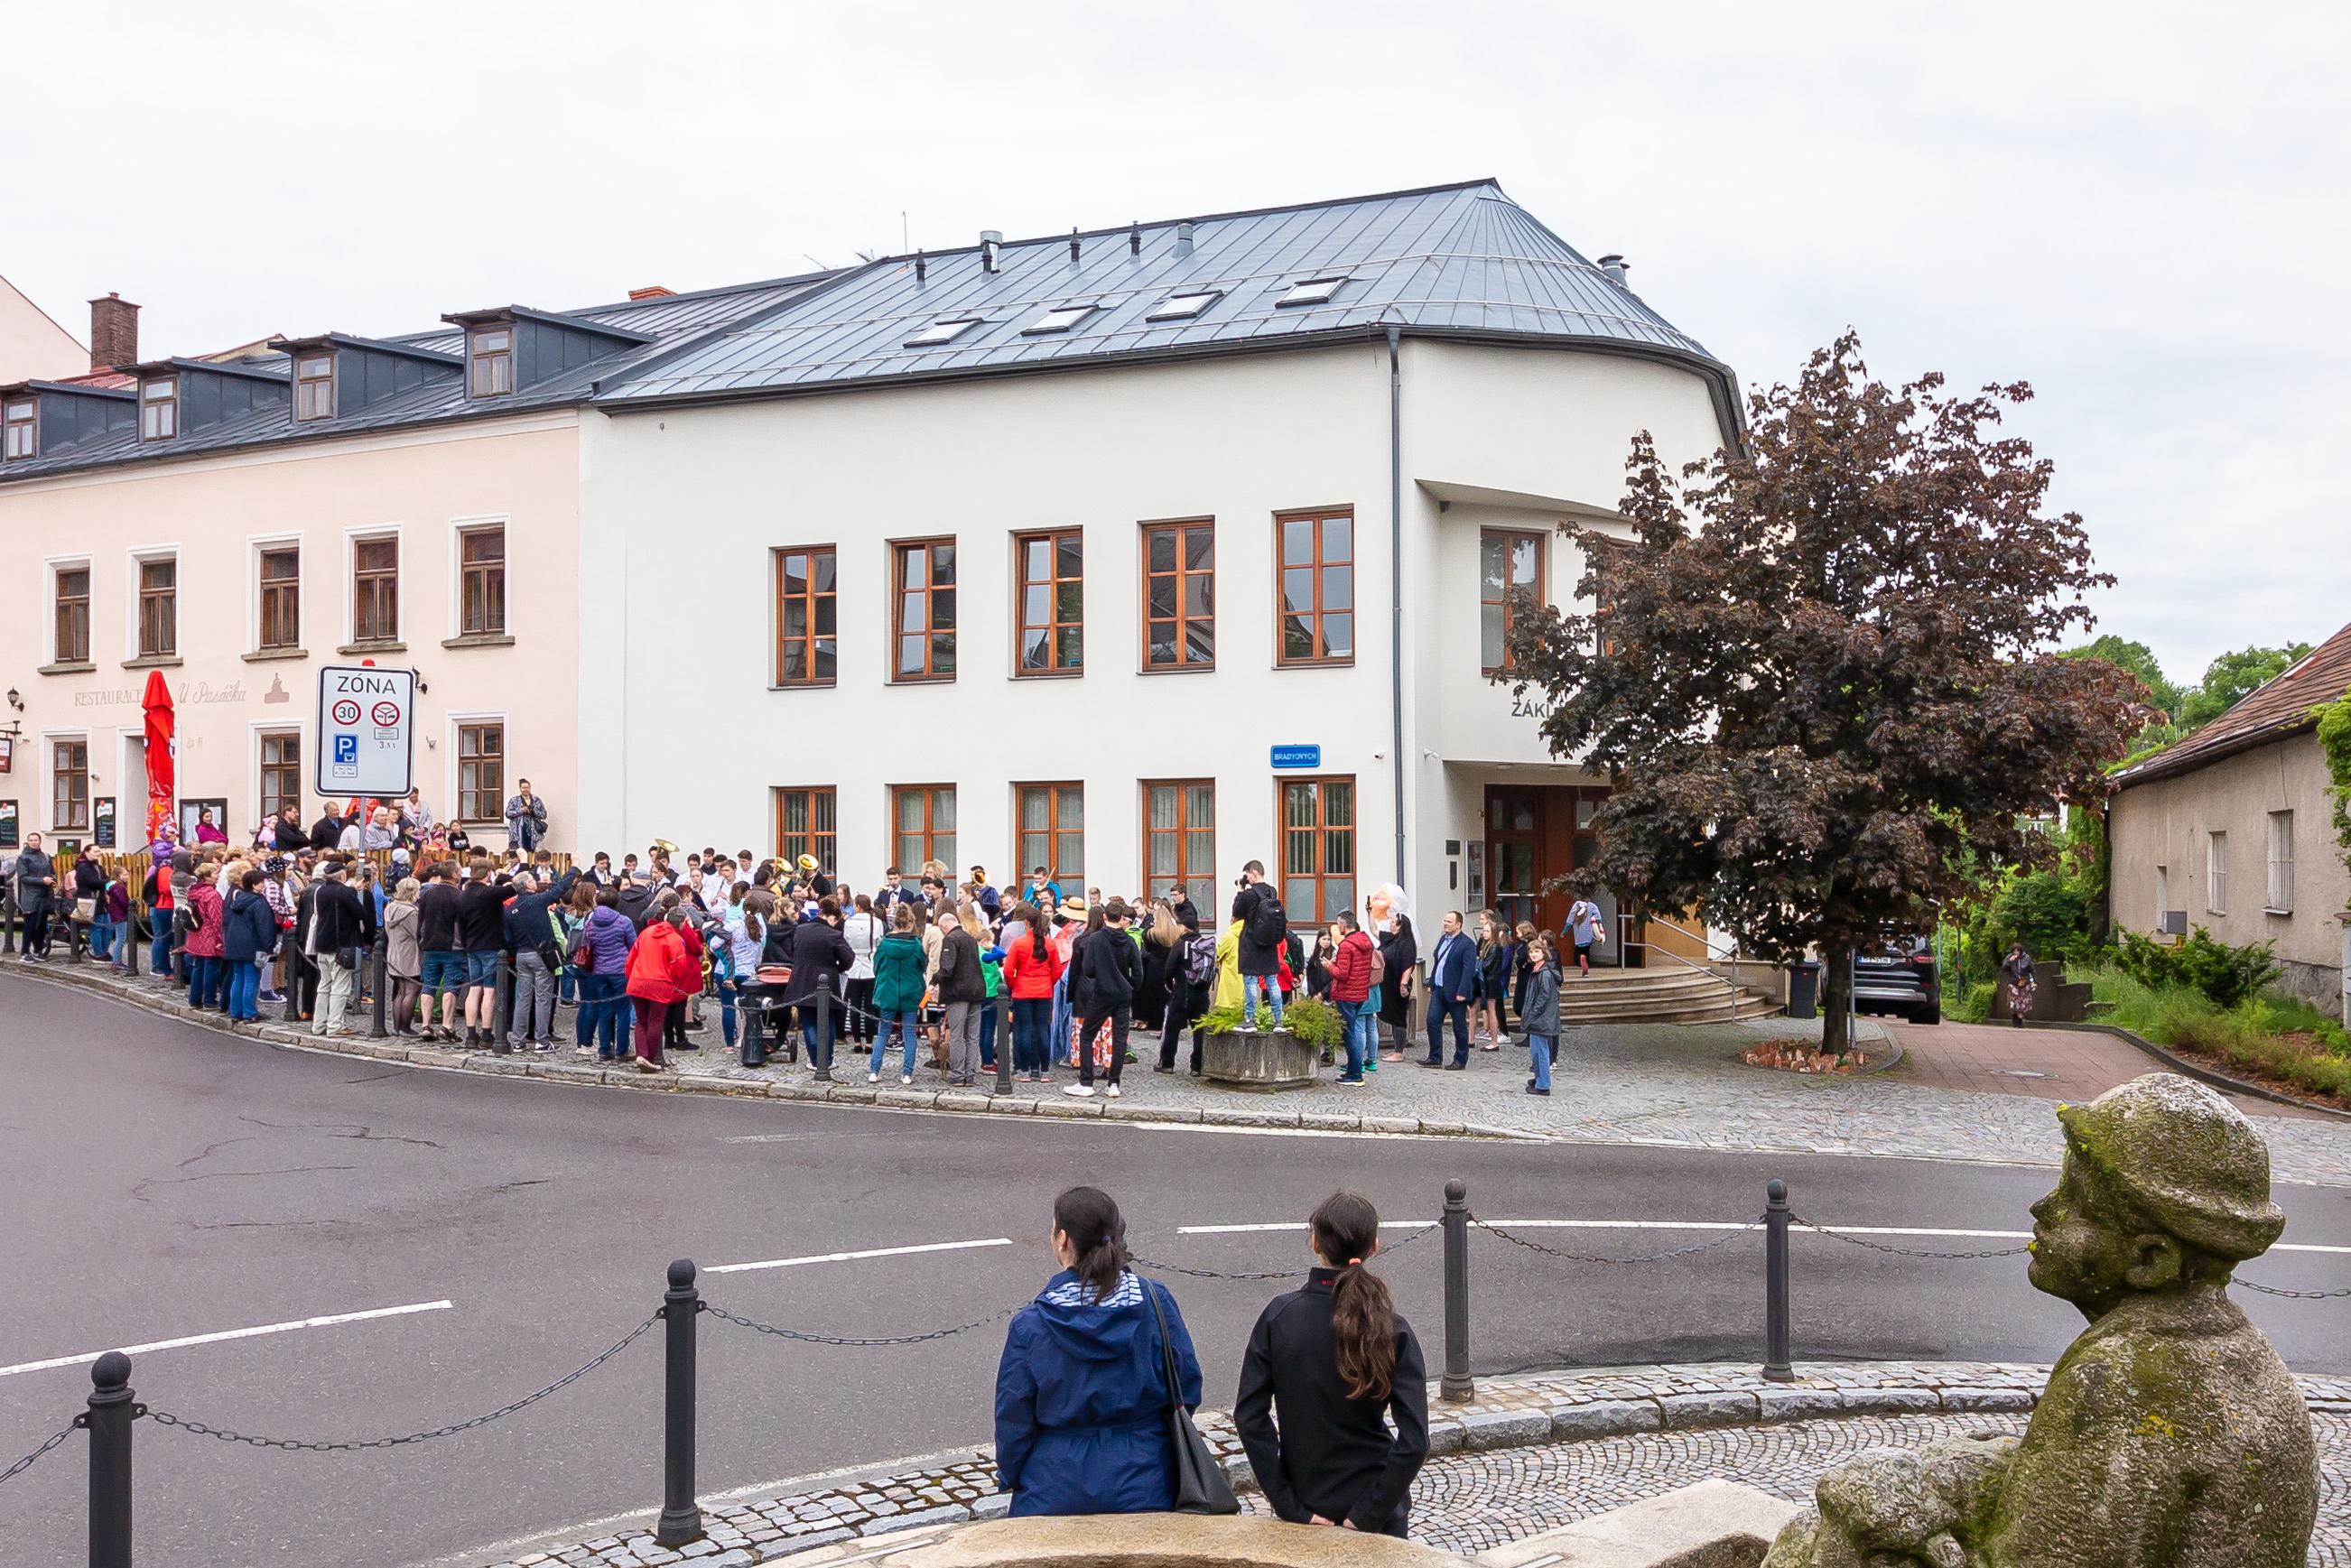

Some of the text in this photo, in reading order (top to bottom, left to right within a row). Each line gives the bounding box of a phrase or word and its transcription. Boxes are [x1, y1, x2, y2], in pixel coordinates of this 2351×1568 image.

[337, 673, 396, 694] ZÓNA
[74, 689, 144, 707] RESTAURACE
[338, 706, 356, 719] 30
[339, 738, 353, 756] P
